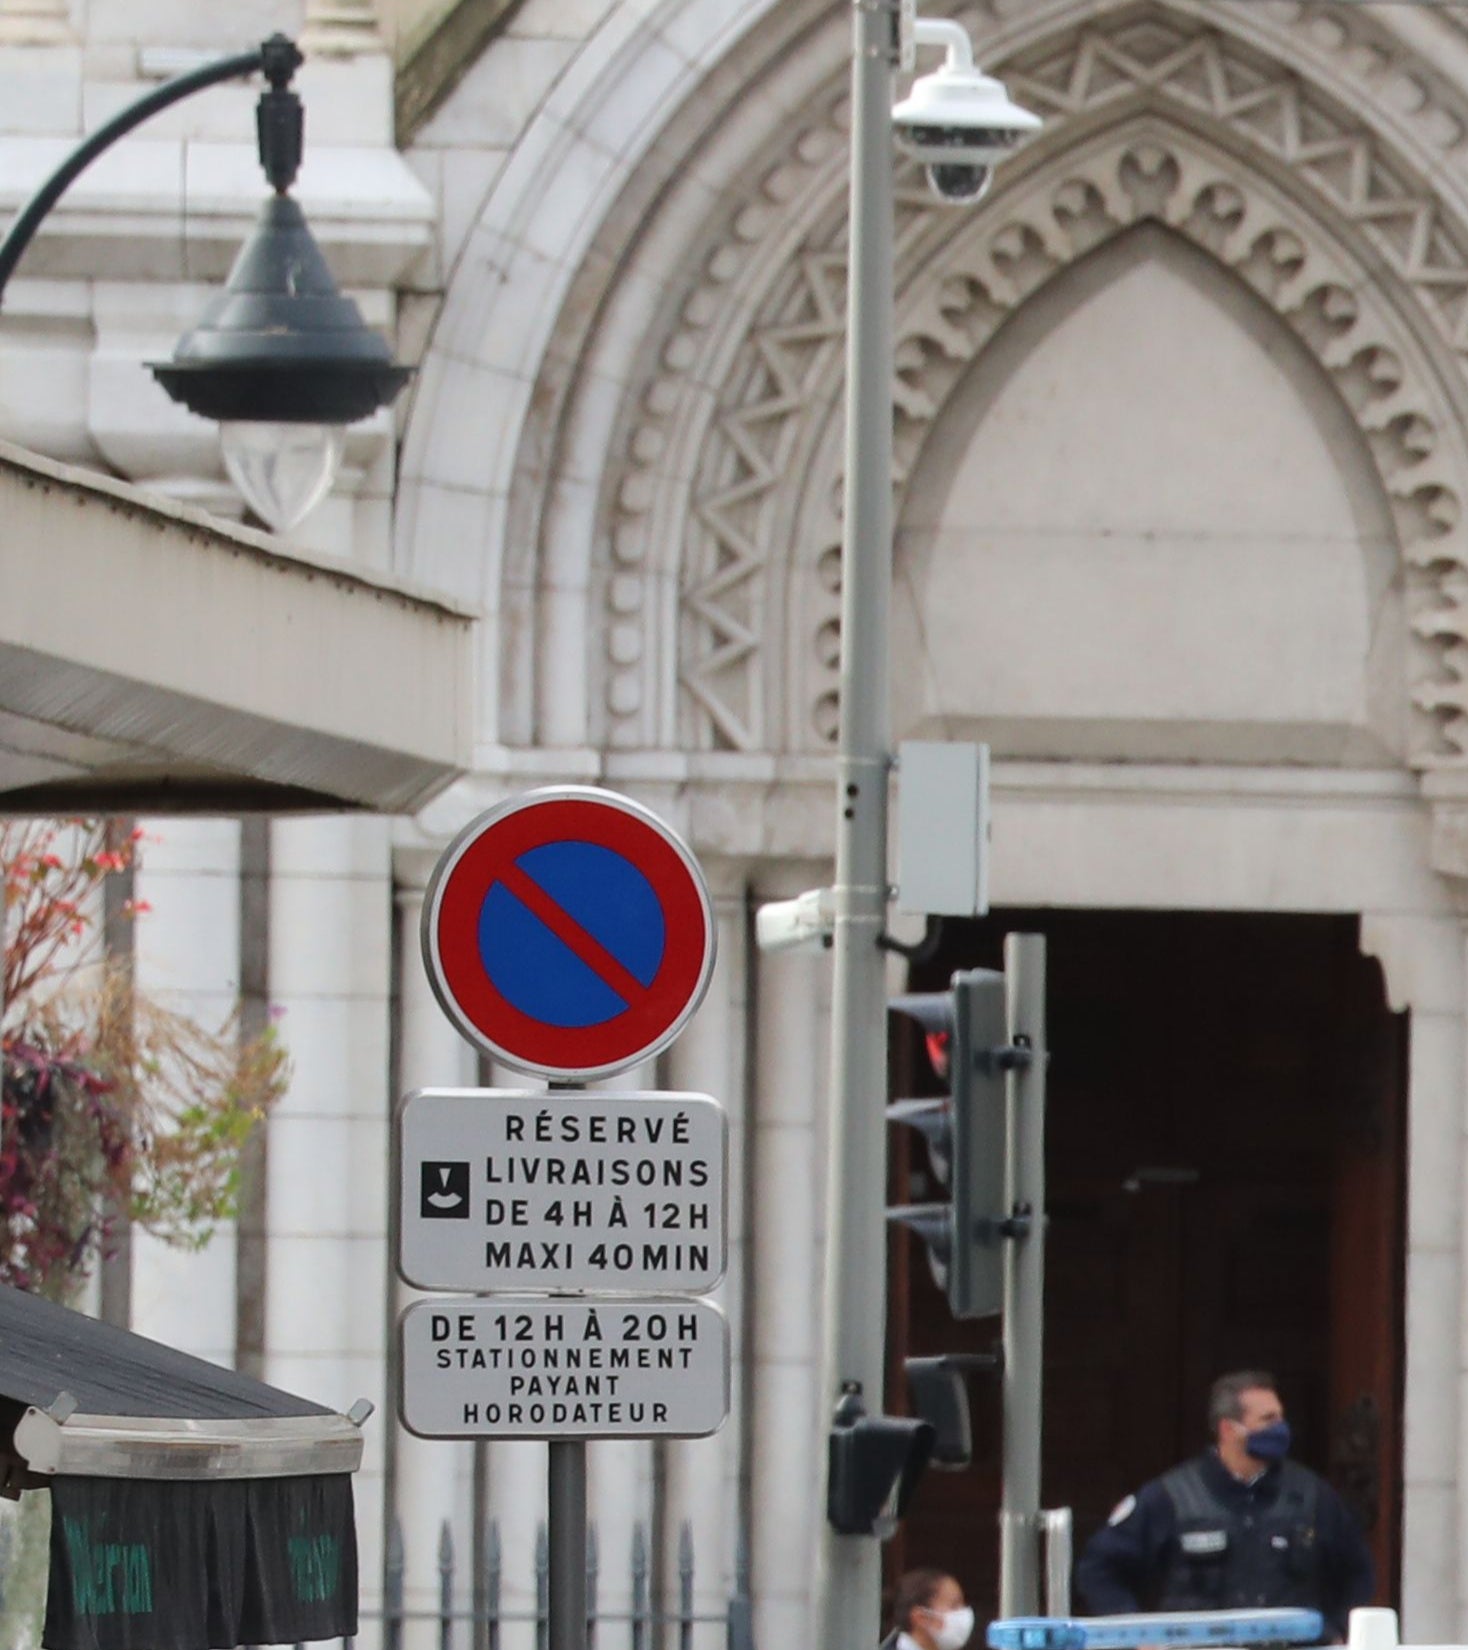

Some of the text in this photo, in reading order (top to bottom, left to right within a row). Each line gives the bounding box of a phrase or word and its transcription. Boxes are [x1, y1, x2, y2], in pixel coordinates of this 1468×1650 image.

[505, 1109, 690, 1144] RÉSERVÉ
[486, 1157, 709, 1187] LIVRAISONS
[486, 1196, 708, 1230] DE 4H À 12H
[485, 1242, 573, 1270] MAXI
[431, 1308, 698, 1342] DE 12H À 20H
[437, 1347, 693, 1369] STATIONNEMENT
[511, 1375, 620, 1397] PAYANT
[463, 1403, 669, 1424] HORODATEUR
